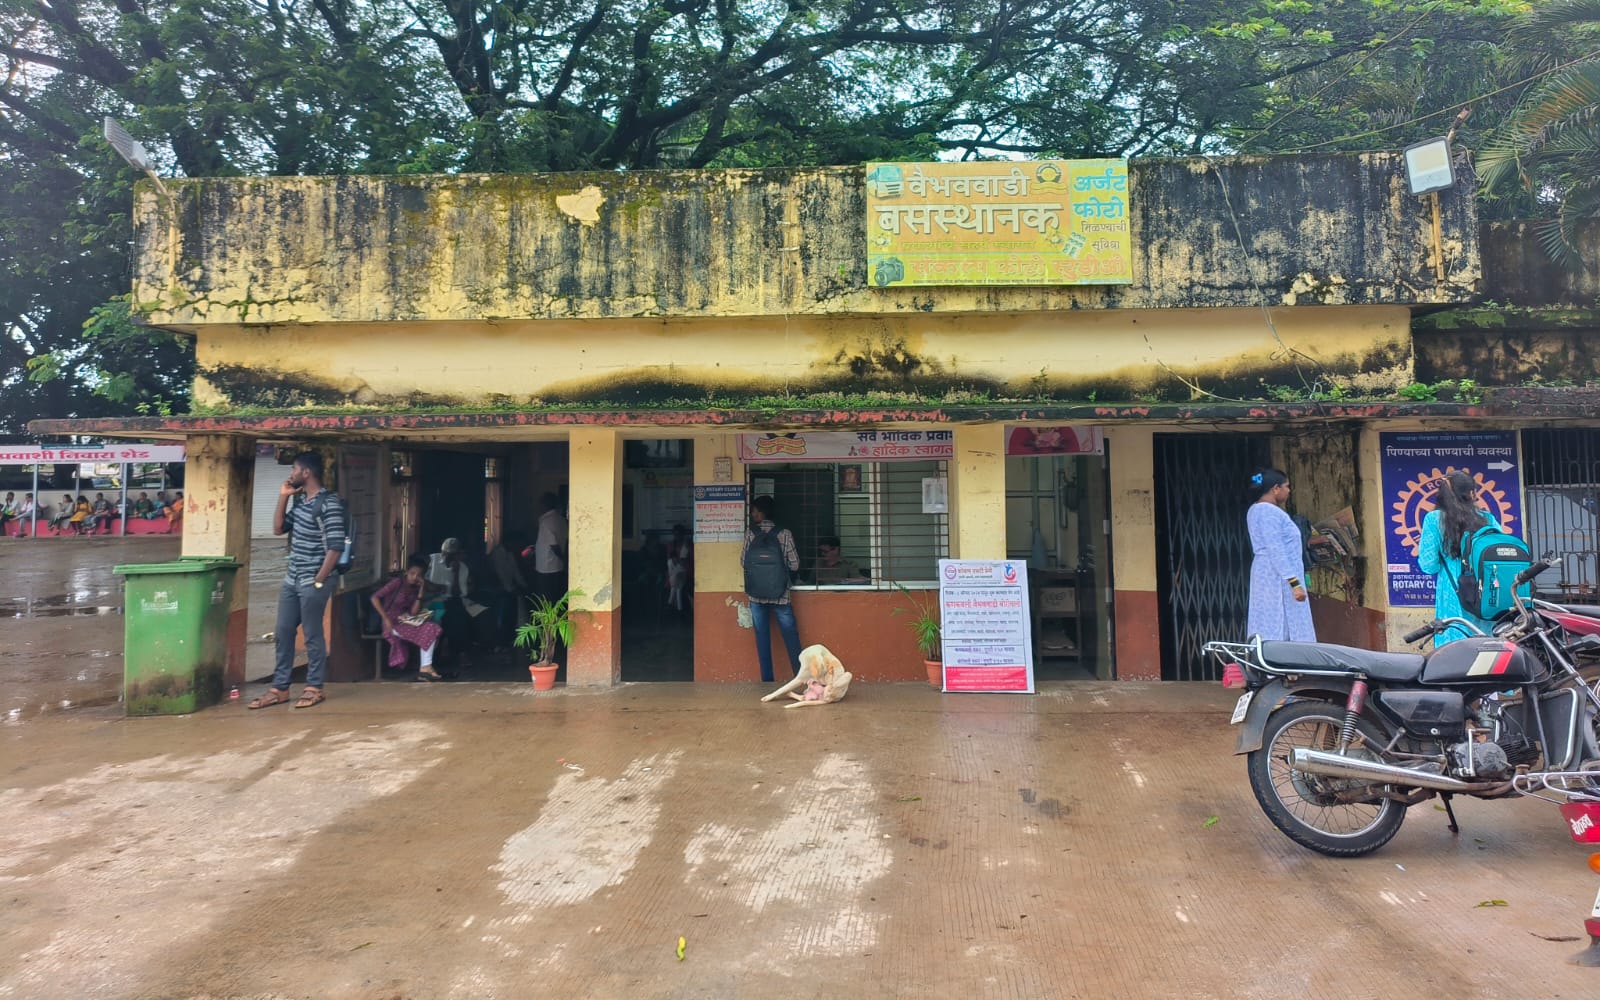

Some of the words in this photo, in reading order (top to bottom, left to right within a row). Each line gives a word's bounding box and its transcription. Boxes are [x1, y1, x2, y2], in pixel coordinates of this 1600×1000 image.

[907, 165, 1031, 197] वैभववाडी
[1073, 196, 1125, 219] फोटो
[876, 203, 1064, 234] बसस्थानक
[121, 448, 149, 459] शेड
[872, 442, 910, 457] हार्दिक
[1386, 444, 1431, 457] पिण्याच्या
[1434, 443, 1474, 457] पाण्याची
[1476, 446, 1512, 457] व्यवस्था
[1392, 580, 1425, 590] ROTARY
